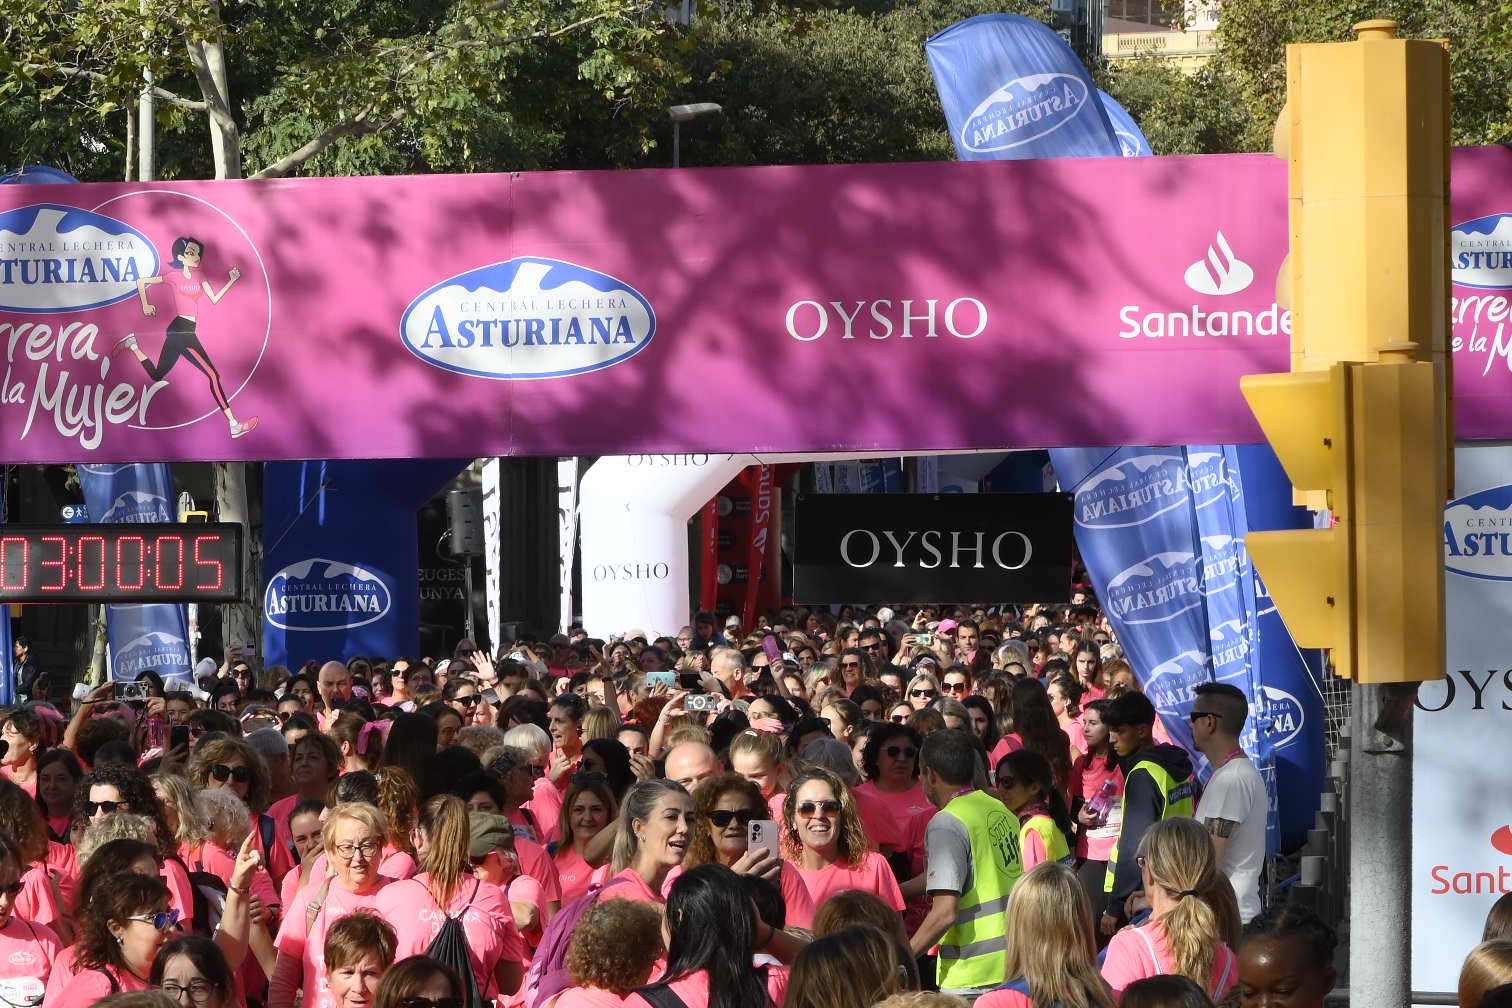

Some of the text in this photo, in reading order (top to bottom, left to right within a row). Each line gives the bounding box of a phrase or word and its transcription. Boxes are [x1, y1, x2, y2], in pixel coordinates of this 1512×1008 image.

[63, 240, 135, 251] LECHERA
[460, 298, 627, 313] CENTRAL LECHERA
[786, 296, 988, 341] OYSHO
[1119, 303, 1294, 339] Santande
[420, 304, 636, 348] ASTURIANA
[1469, 324, 1489, 353] la
[1, 364, 25, 404] la
[20, 356, 170, 450] Mujer
[0, 535, 224, 591] 03:00:05
[840, 528, 1033, 571] OYSHO
[281, 583, 376, 592] CENTRAL LECHERA
[593, 562, 669, 581] OYSHO
[268, 588, 381, 615] ASTURIANA
